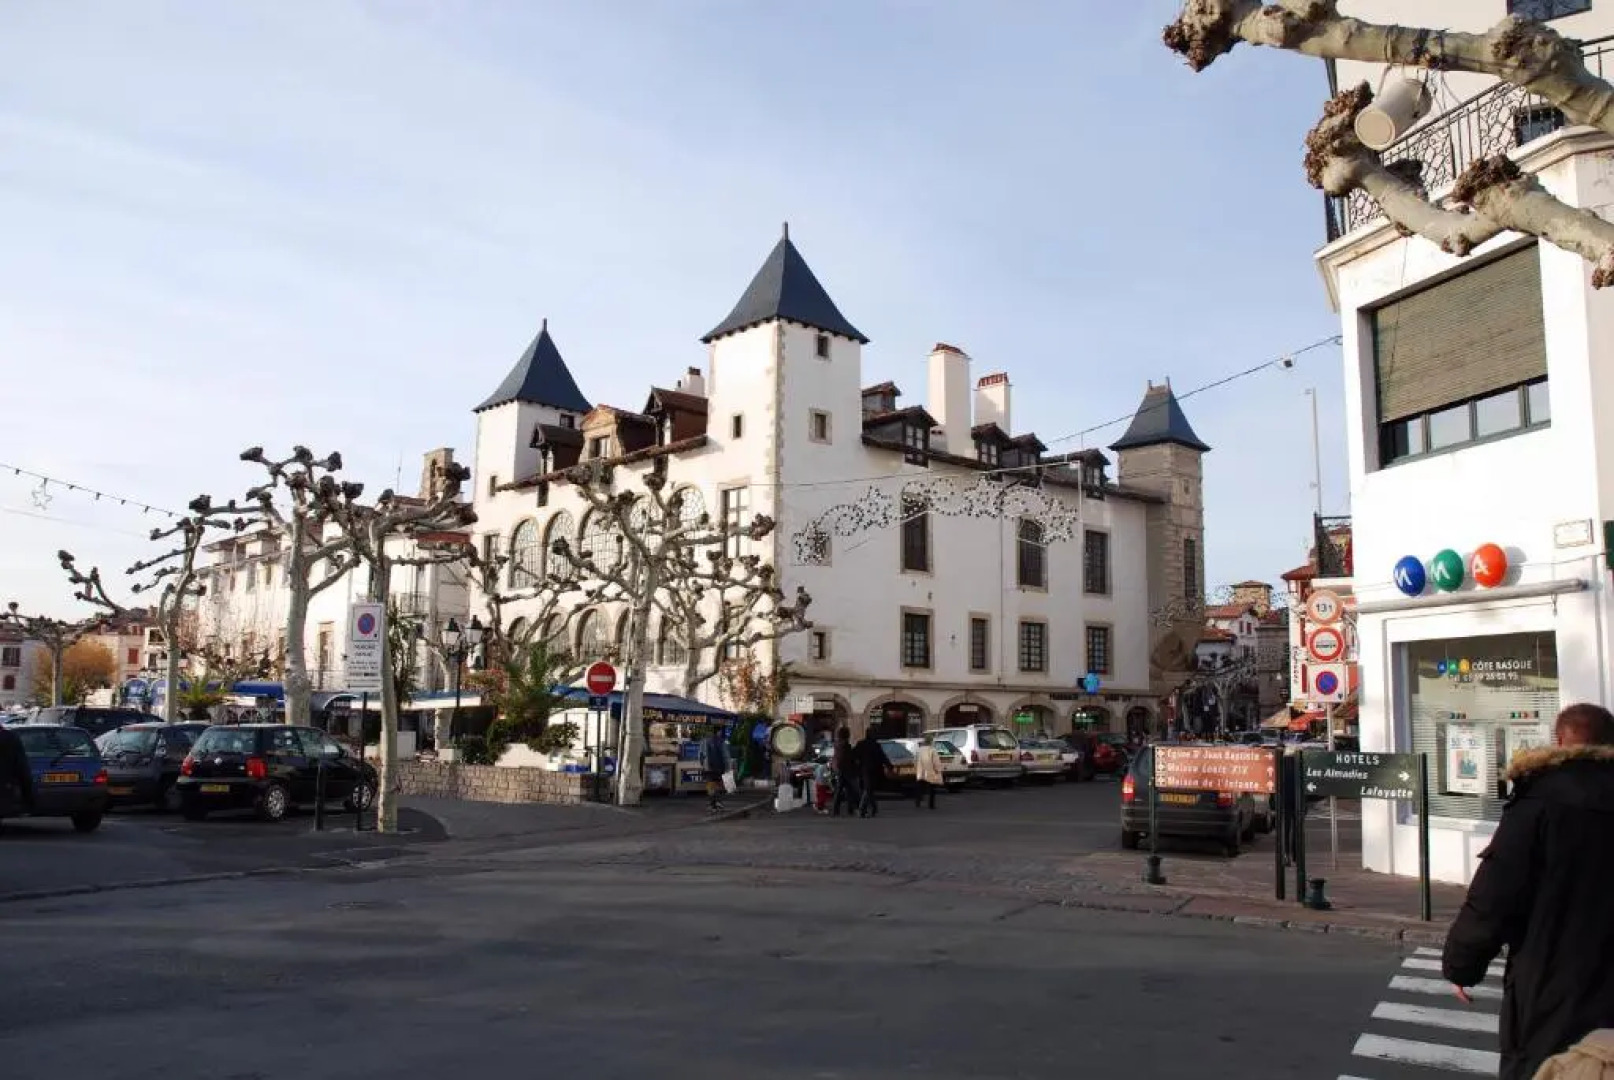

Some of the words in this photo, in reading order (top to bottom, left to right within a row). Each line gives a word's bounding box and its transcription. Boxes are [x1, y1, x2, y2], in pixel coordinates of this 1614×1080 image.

[1394, 553, 1492, 588] MMA
[1495, 660, 1533, 671] BASQUE
[1335, 754, 1380, 765] HOTELS
[1167, 762, 1199, 772] Maison
[1306, 767, 1322, 777] Les
[1323, 768, 1369, 780] Almadies
[1167, 778, 1199, 788] Maison
[1202, 779, 1213, 788] de
[1361, 786, 1414, 799] Lafayette
